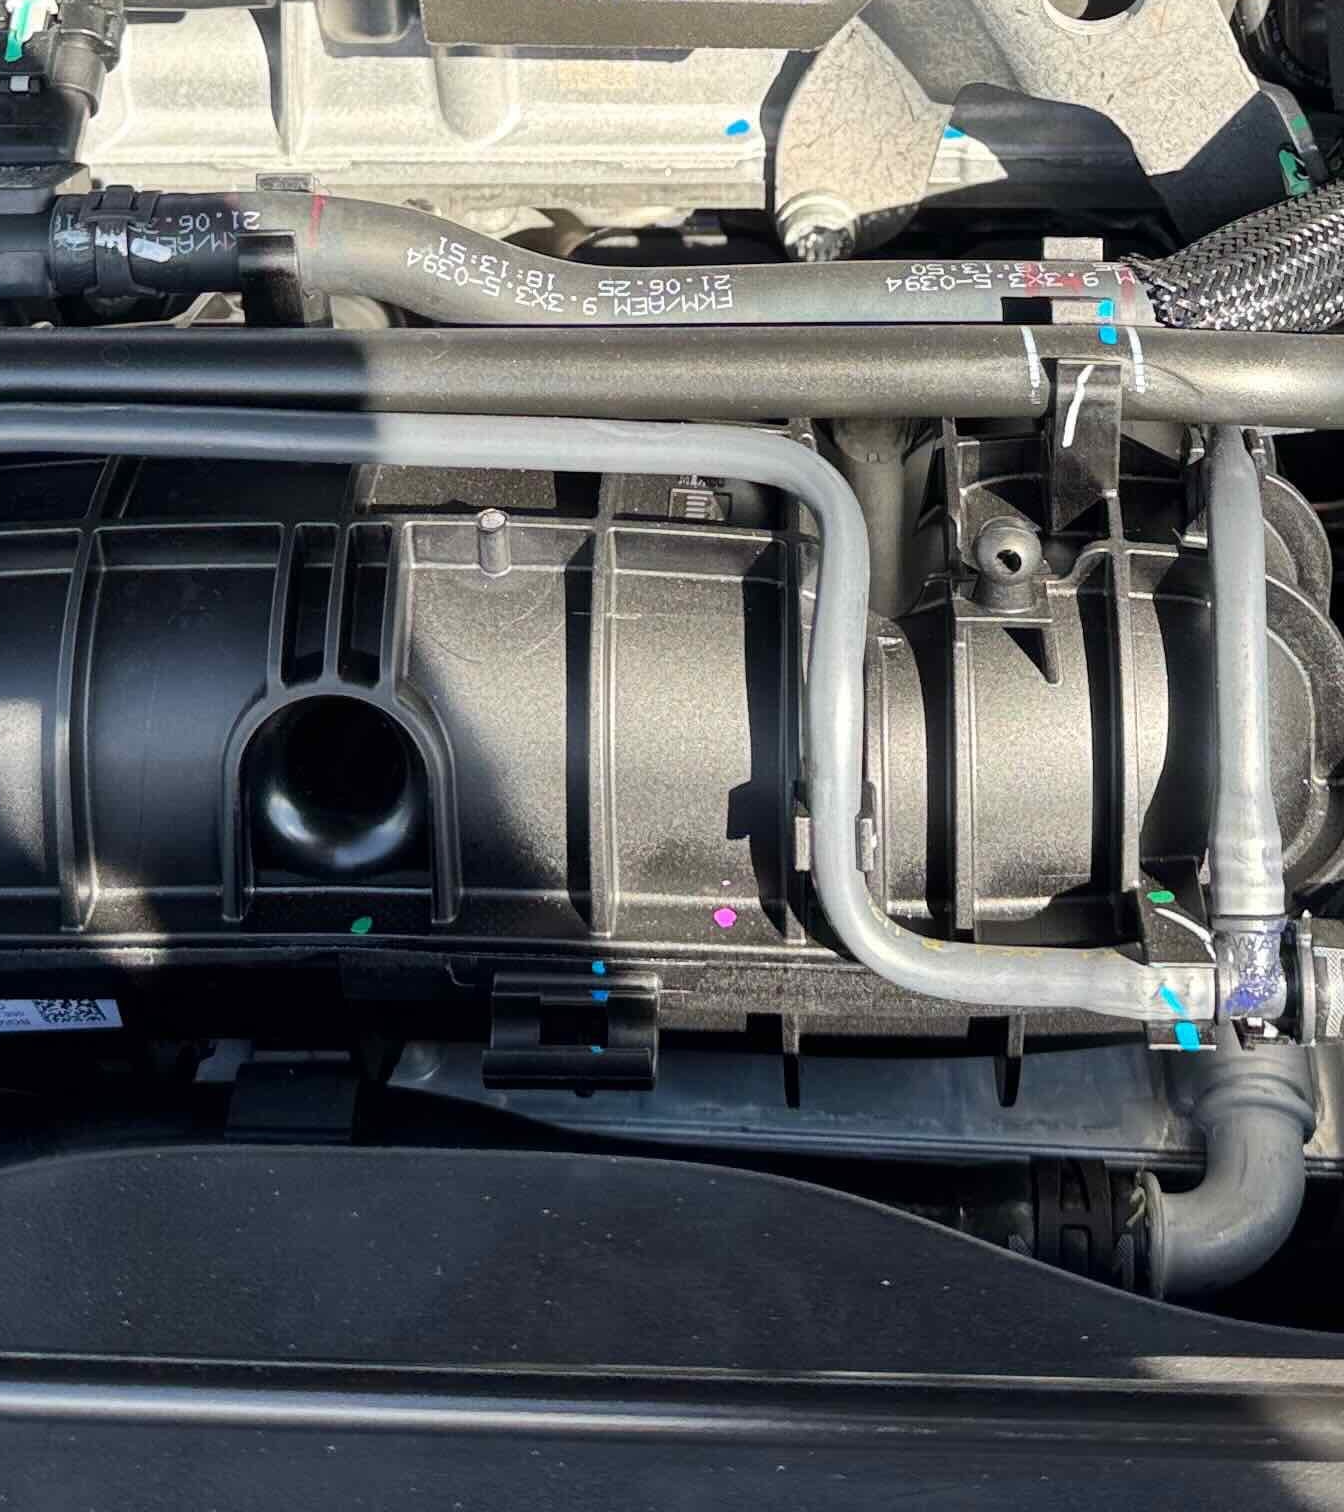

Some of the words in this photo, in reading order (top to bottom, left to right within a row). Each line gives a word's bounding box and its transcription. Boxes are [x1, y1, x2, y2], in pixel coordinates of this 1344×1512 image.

[439, 236, 556, 292] 18:13:51
[406, 247, 598, 316] 9.3X3.5-0394
[598, 274, 731, 297] 21.06.25
[885, 272, 1100, 293] 9.3X3.5-0394
[613, 290, 734, 317] FKM/AEM
